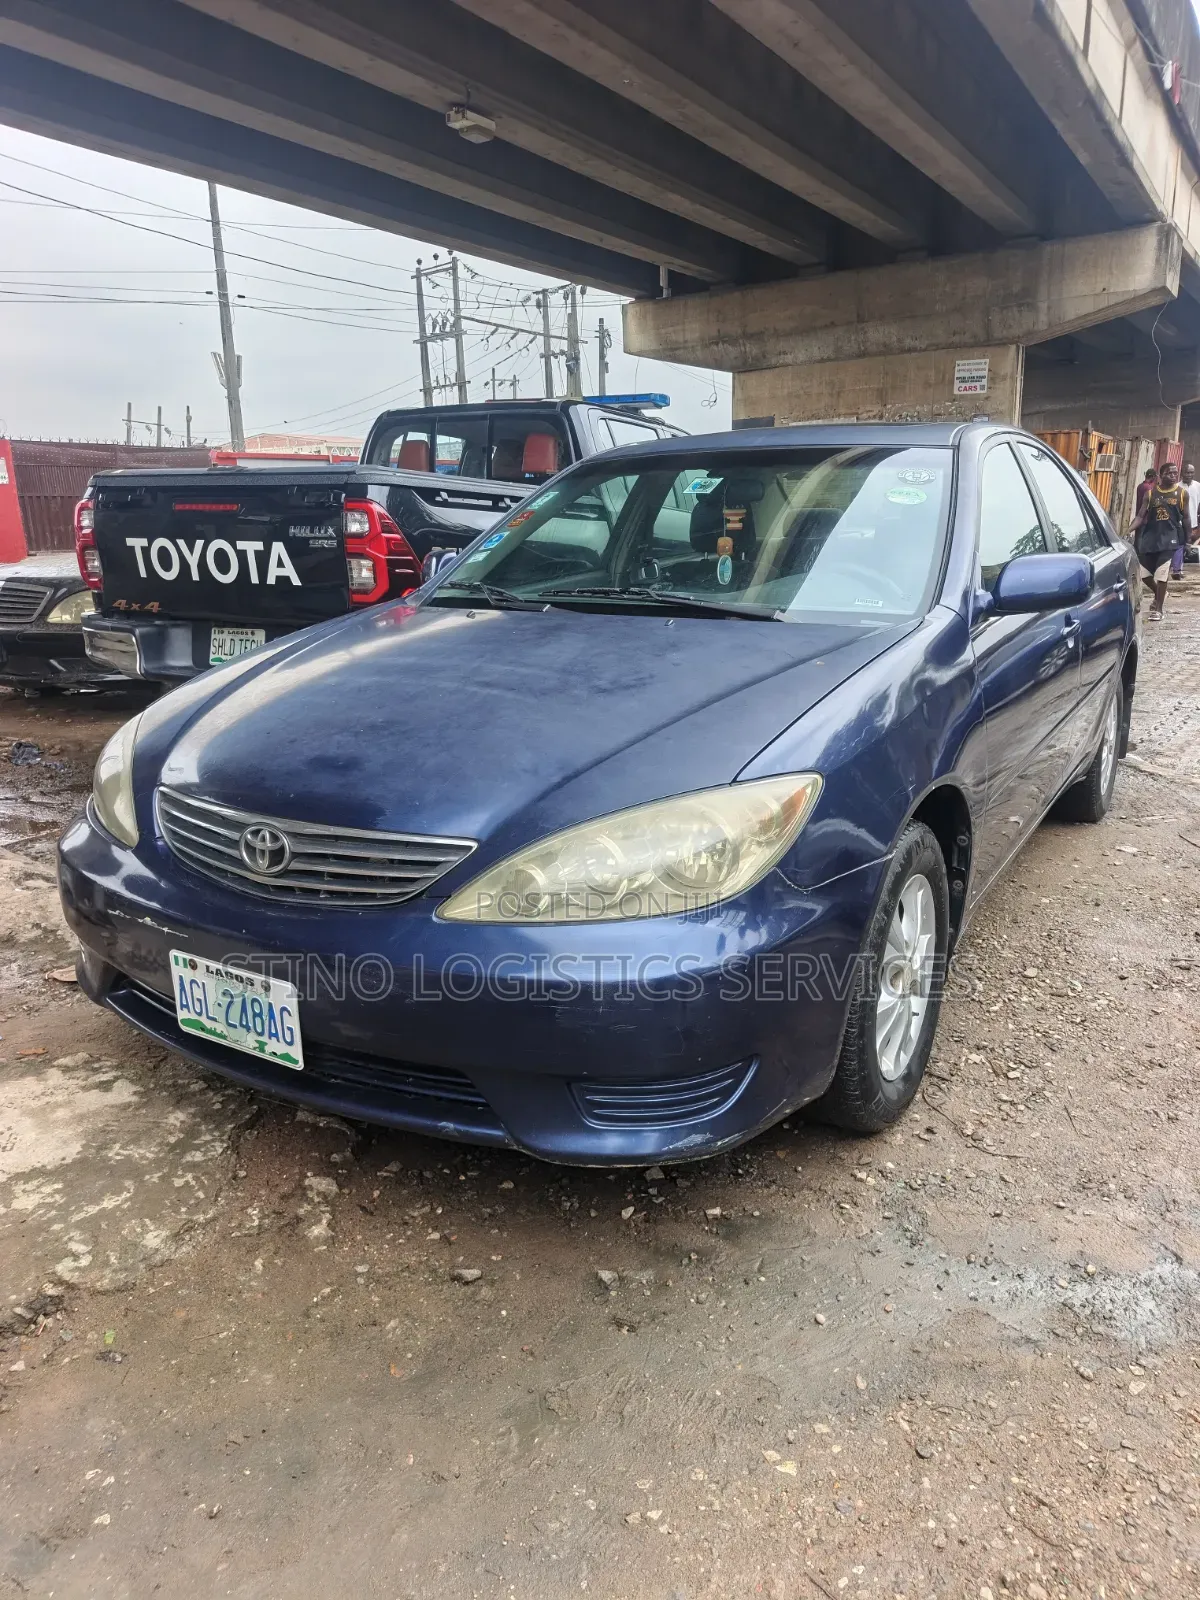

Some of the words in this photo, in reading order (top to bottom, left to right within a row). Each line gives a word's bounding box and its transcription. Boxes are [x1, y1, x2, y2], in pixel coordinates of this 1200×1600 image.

[289, 525, 336, 537] HILUX
[125, 537, 302, 587] TOYOTA
[211, 637, 236, 657] SHLD
[205, 964, 255, 987] LAGOS
